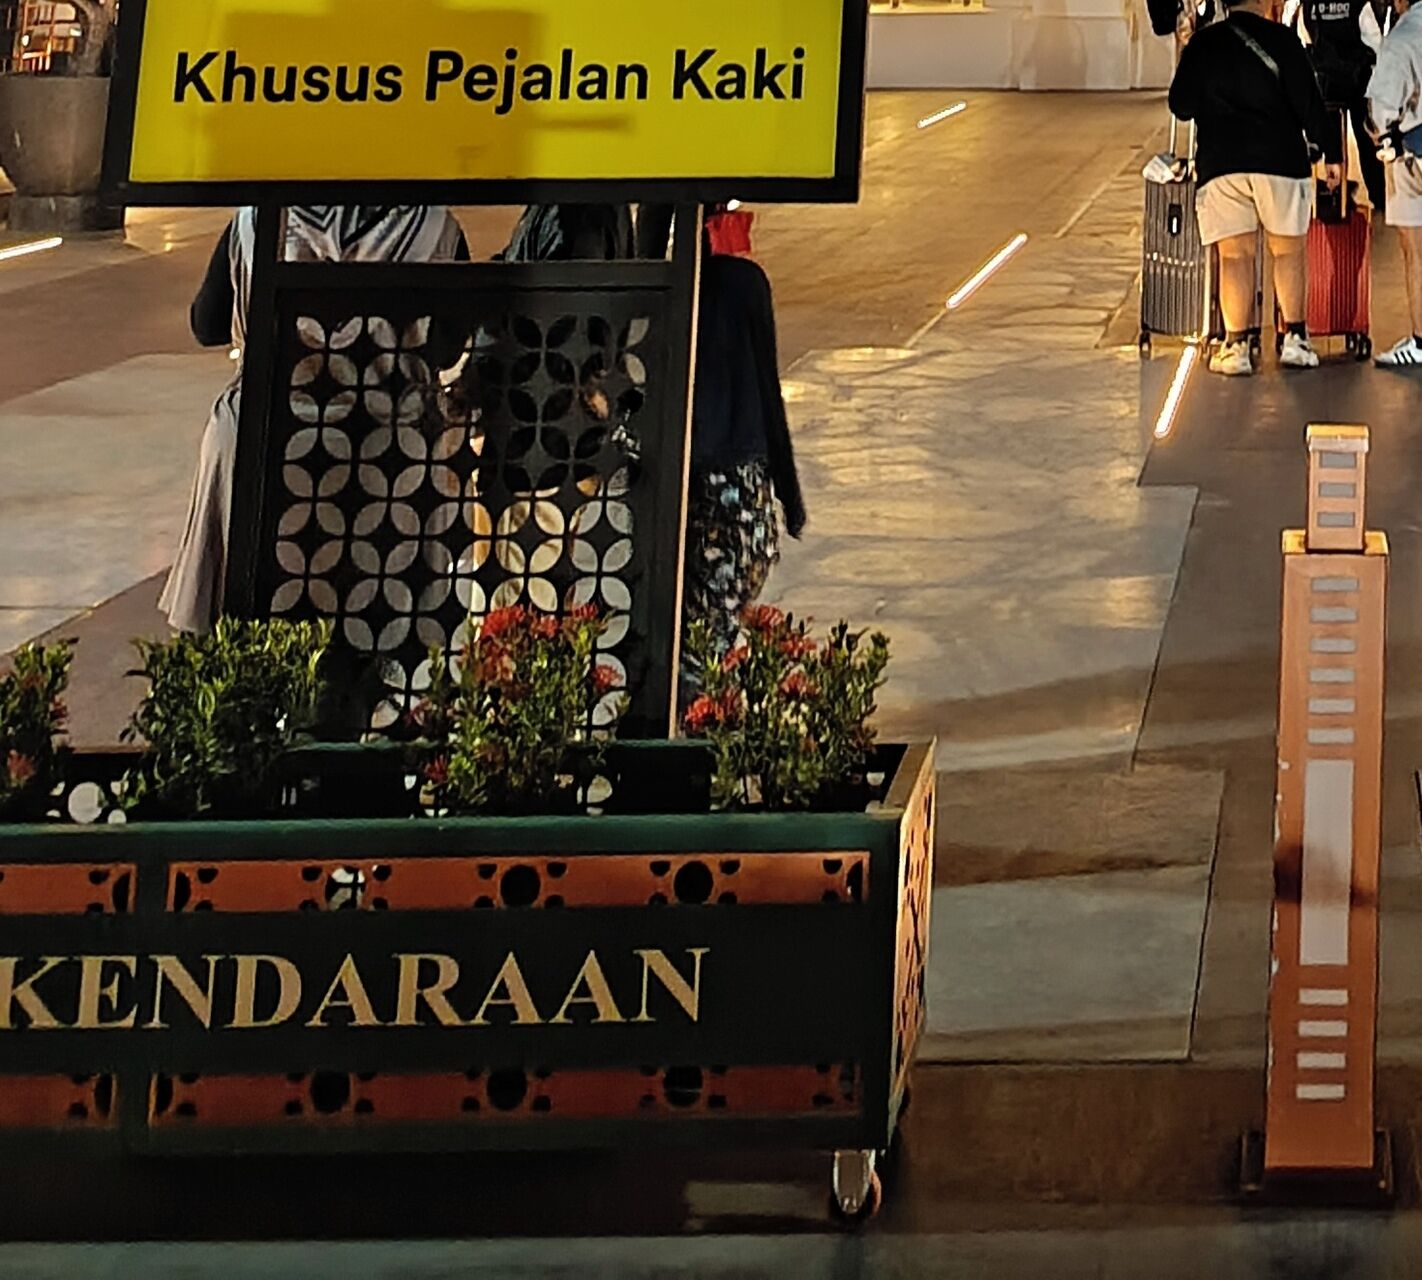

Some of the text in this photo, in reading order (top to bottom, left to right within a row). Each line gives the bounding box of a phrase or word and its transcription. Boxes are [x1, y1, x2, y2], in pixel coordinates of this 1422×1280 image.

[173, 46, 805, 115] Khusus Pejalan Kaki
[0, 947, 711, 1030] KENDARAAN
